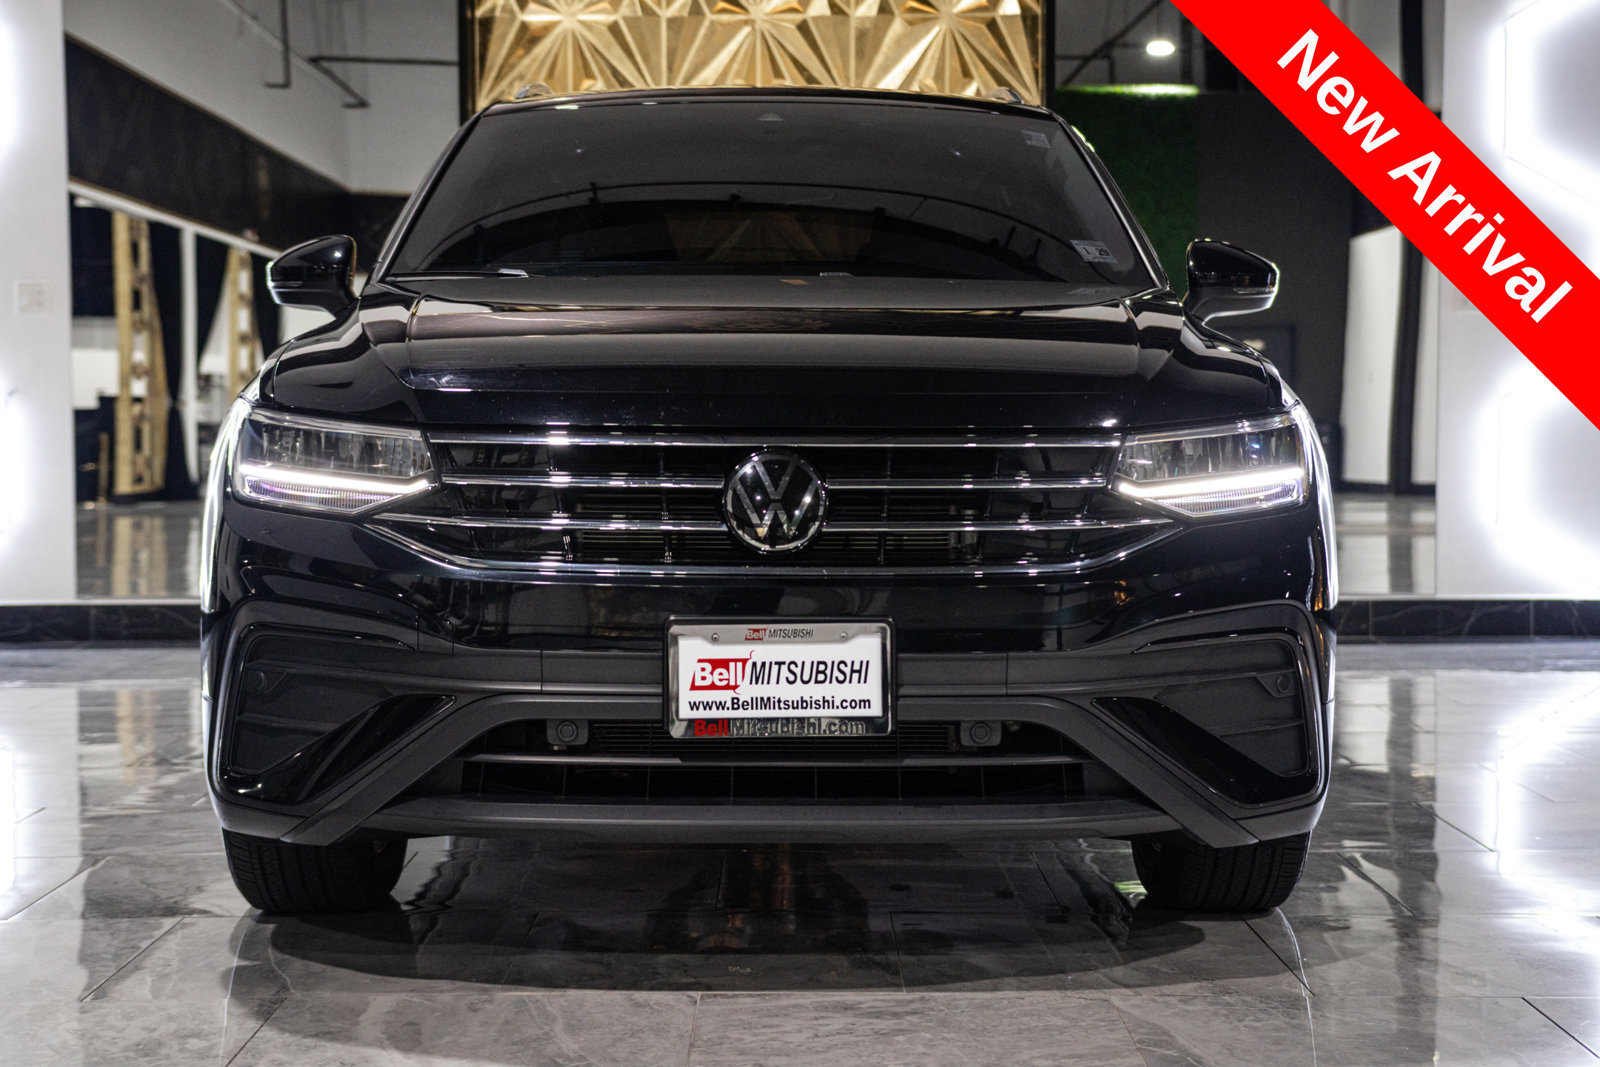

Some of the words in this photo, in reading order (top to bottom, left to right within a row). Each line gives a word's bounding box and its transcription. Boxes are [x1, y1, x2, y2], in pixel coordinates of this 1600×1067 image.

[745, 628, 767, 640] Bell
[768, 628, 814, 639] MITSUBISHI
[692, 659, 747, 689] Bell
[749, 660, 870, 685] MITSUBISHI
[688, 696, 872, 711] www.BellMitsubishi.com
